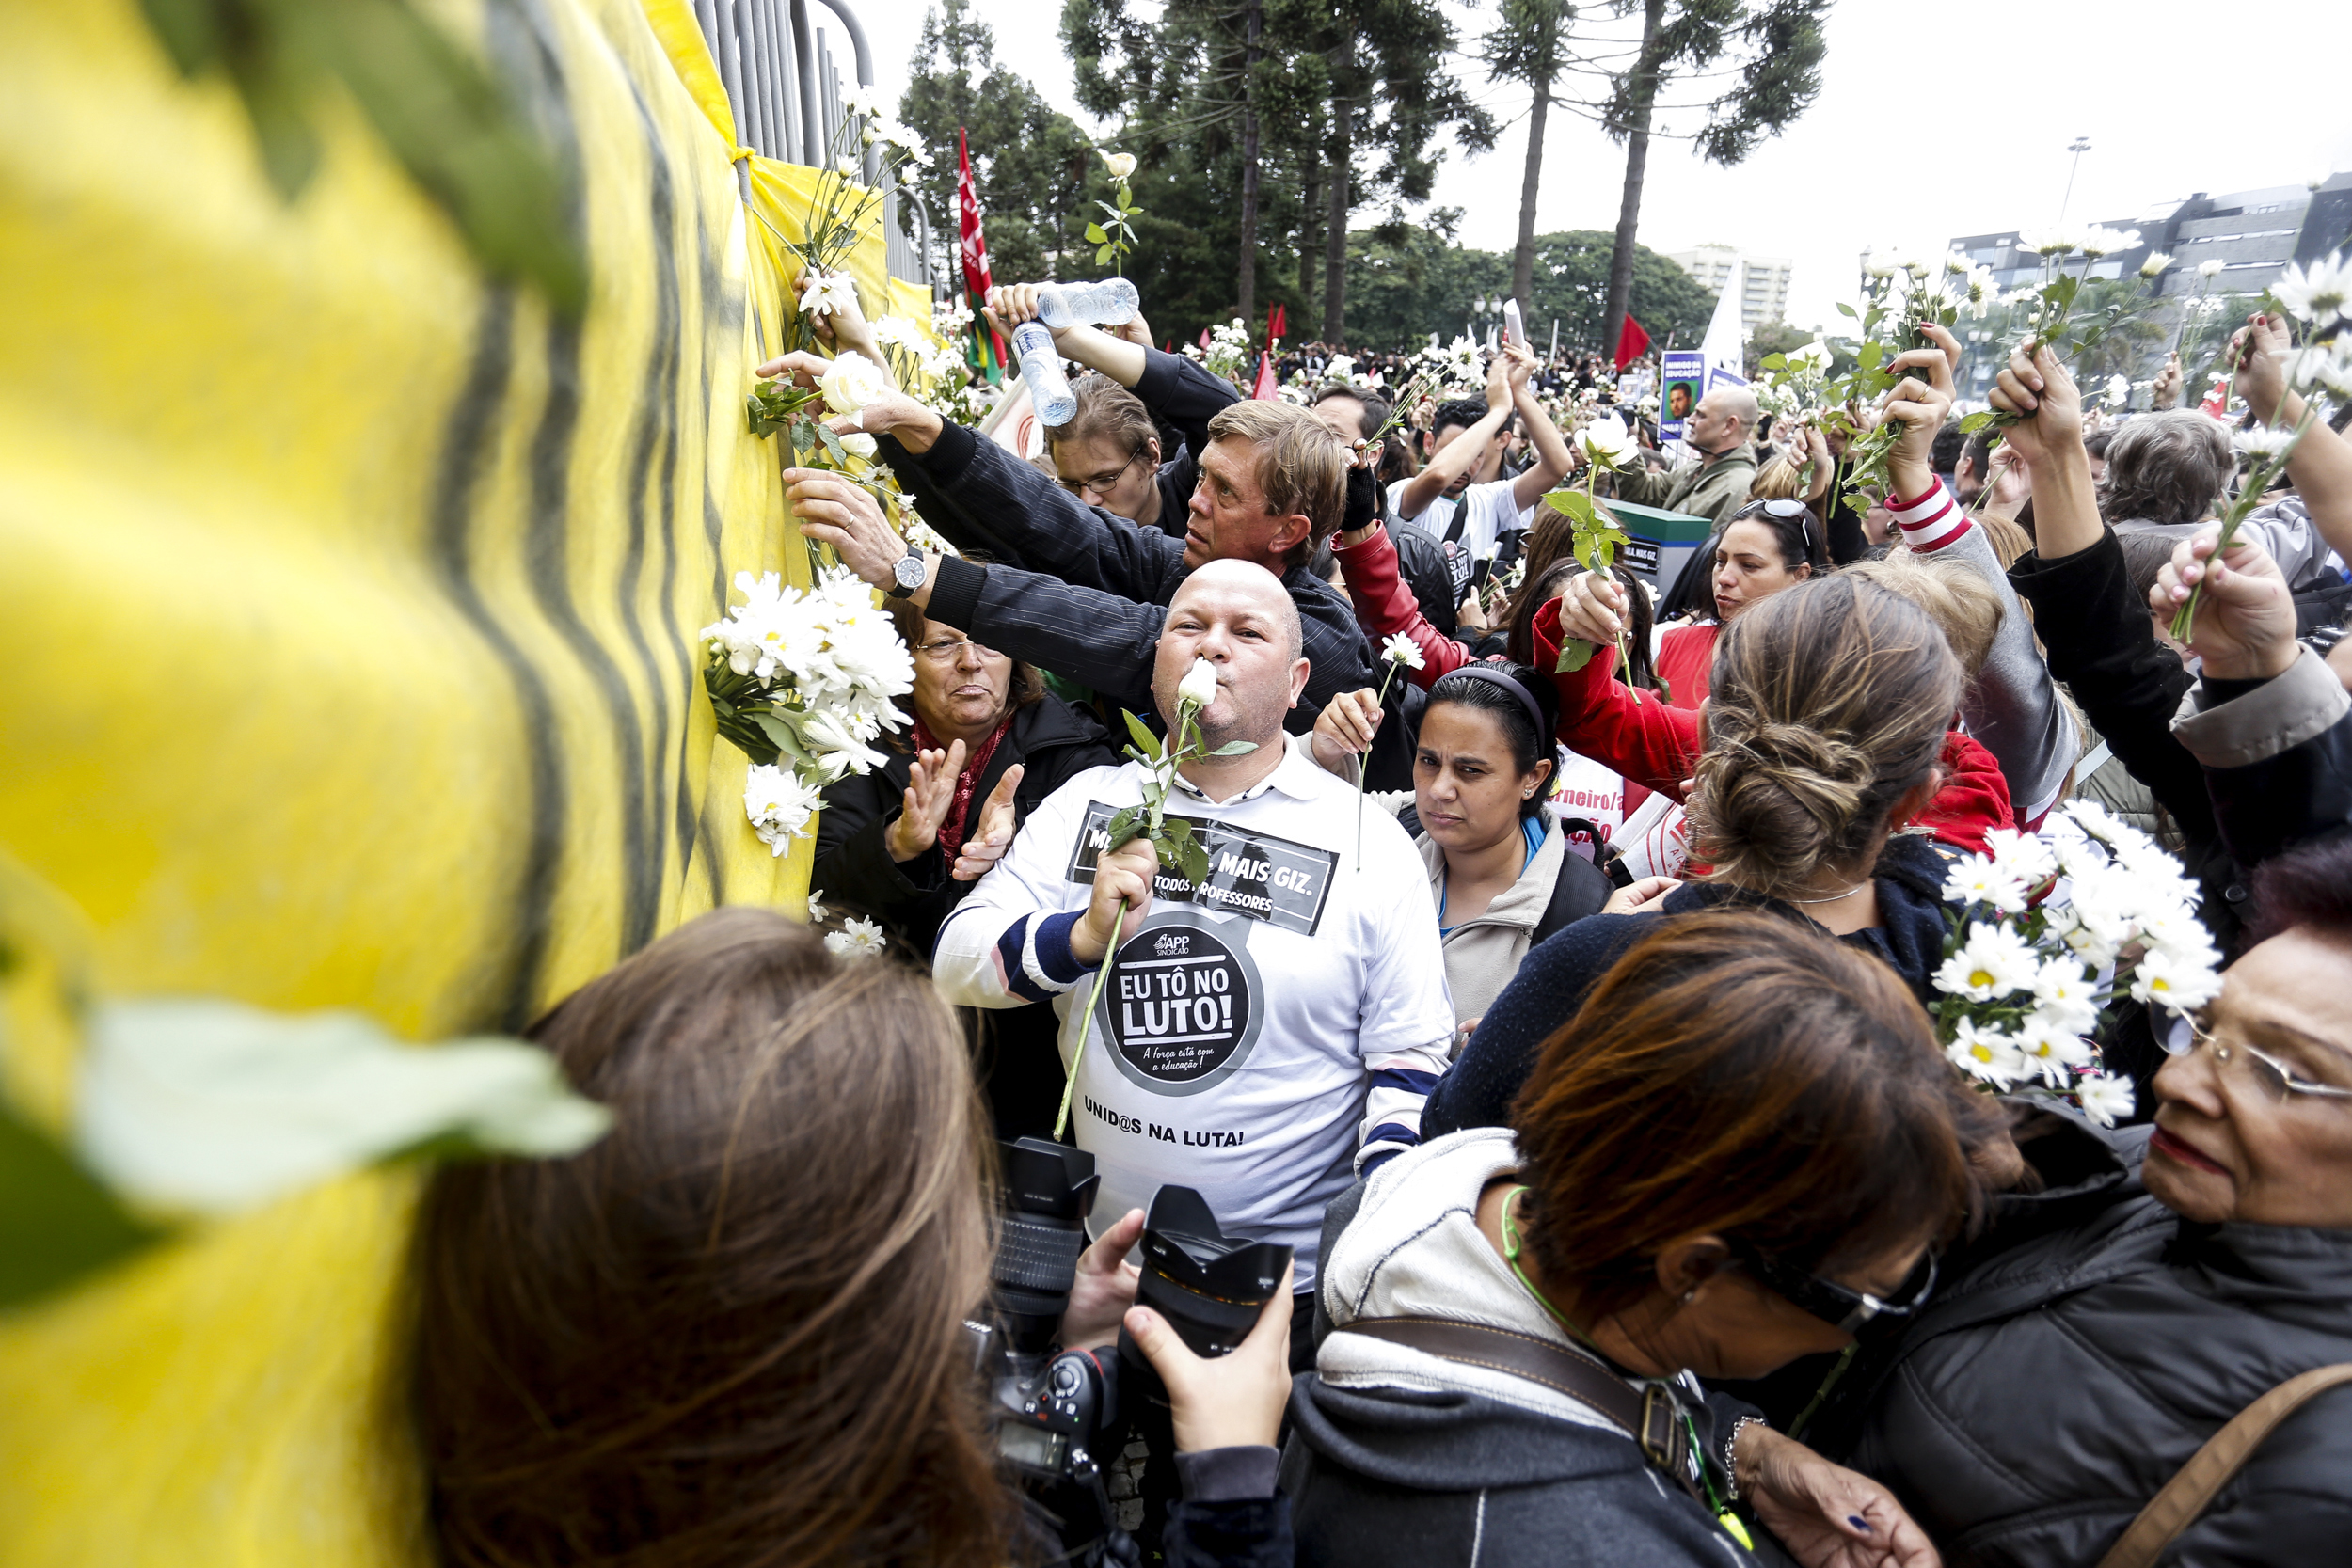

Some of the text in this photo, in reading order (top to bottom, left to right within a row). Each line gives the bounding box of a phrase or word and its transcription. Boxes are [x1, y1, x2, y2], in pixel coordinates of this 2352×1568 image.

[1665, 369, 1702, 378] EDUCAÇÃO
[1451, 563, 1469, 581] TO!
[1217, 851, 1272, 882] MAIS
[1273, 866, 1313, 896] GIZ.
[1154, 875, 1274, 911] TODOS ROFESSORES
[1156, 947, 1190, 957] SINDICATO
[1165, 935, 1190, 949] APP
[1120, 965, 1229, 999] EU TÔ NO
[1122, 994, 1233, 1036] LUTO!
[1143, 1046, 1215, 1061] A força está com
[1084, 1095, 1244, 1148] UNID@S NA LUTA!
